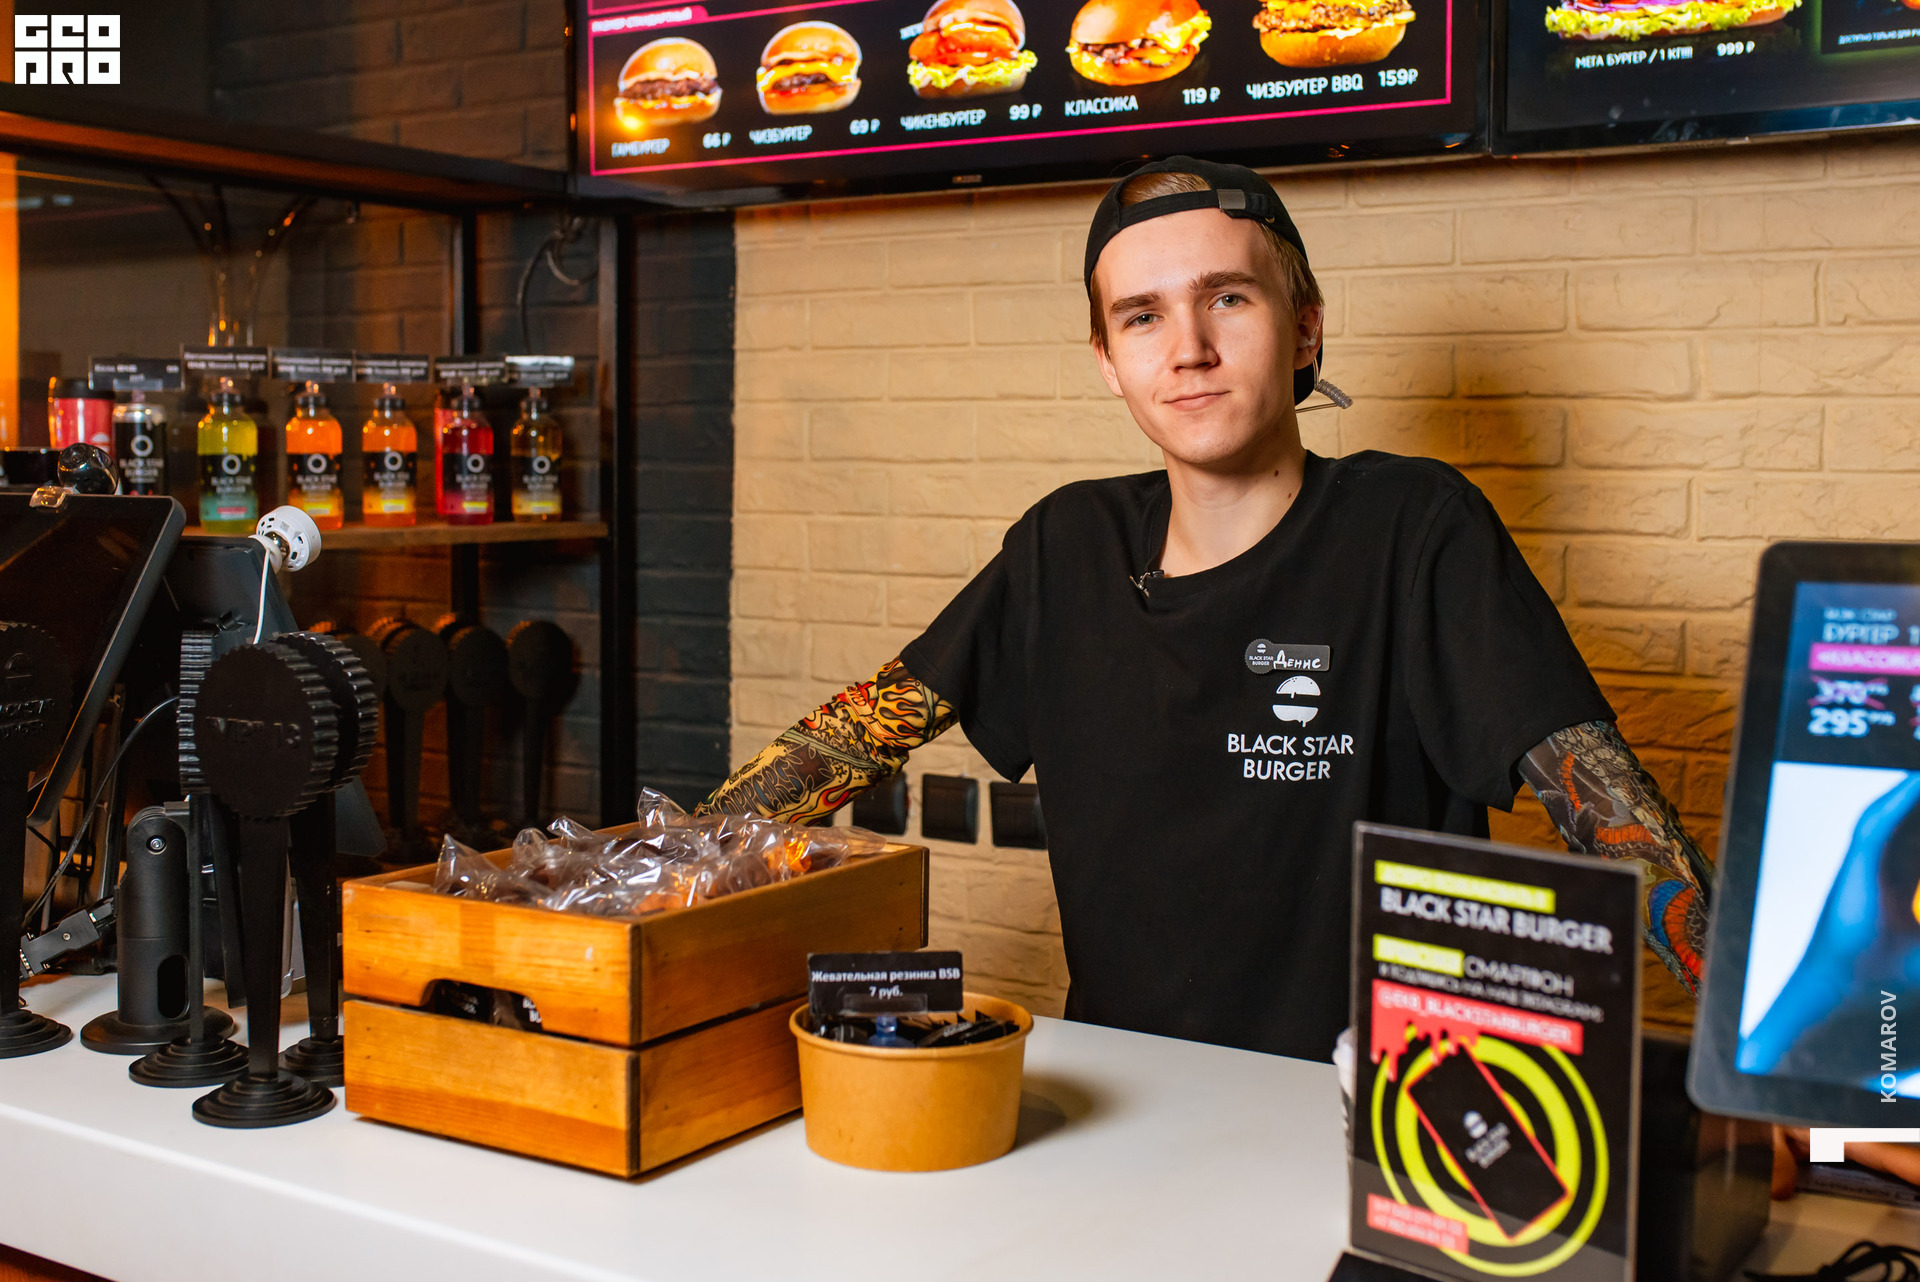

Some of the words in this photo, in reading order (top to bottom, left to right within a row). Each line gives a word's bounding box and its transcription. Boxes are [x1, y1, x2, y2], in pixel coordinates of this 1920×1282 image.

[1575, 55, 1605, 70] МЕГА
[1606, 50, 1648, 67] БУРГЕР
[1659, 48, 1666, 61] 1
[1716, 42, 1744, 57] 999
[1182, 87, 1208, 105] 119
[1246, 76, 1329, 101] ЧИЗБУРГЕР
[1331, 72, 1364, 94] BBQ
[1009, 104, 1030, 121] 99
[1064, 95, 1139, 118] КЛАССИКА
[849, 119, 869, 135] 69
[900, 108, 987, 131] ЧИКЕНБУРГЕР
[703, 133, 721, 149] 66
[1227, 733, 1297, 756] BLACK
[1302, 734, 1354, 757] STAR
[1243, 758, 1331, 782] BURGER
[1380, 886, 1452, 923] BLACK
[1453, 899, 1511, 935] STAR
[1512, 911, 1613, 955] BURGER
[811, 970, 887, 983] Жевательная
[890, 969, 937, 982] резинка
[938, 967, 961, 980] BSB
[869, 986, 876, 997] 7
[878, 985, 903, 999] руб.
